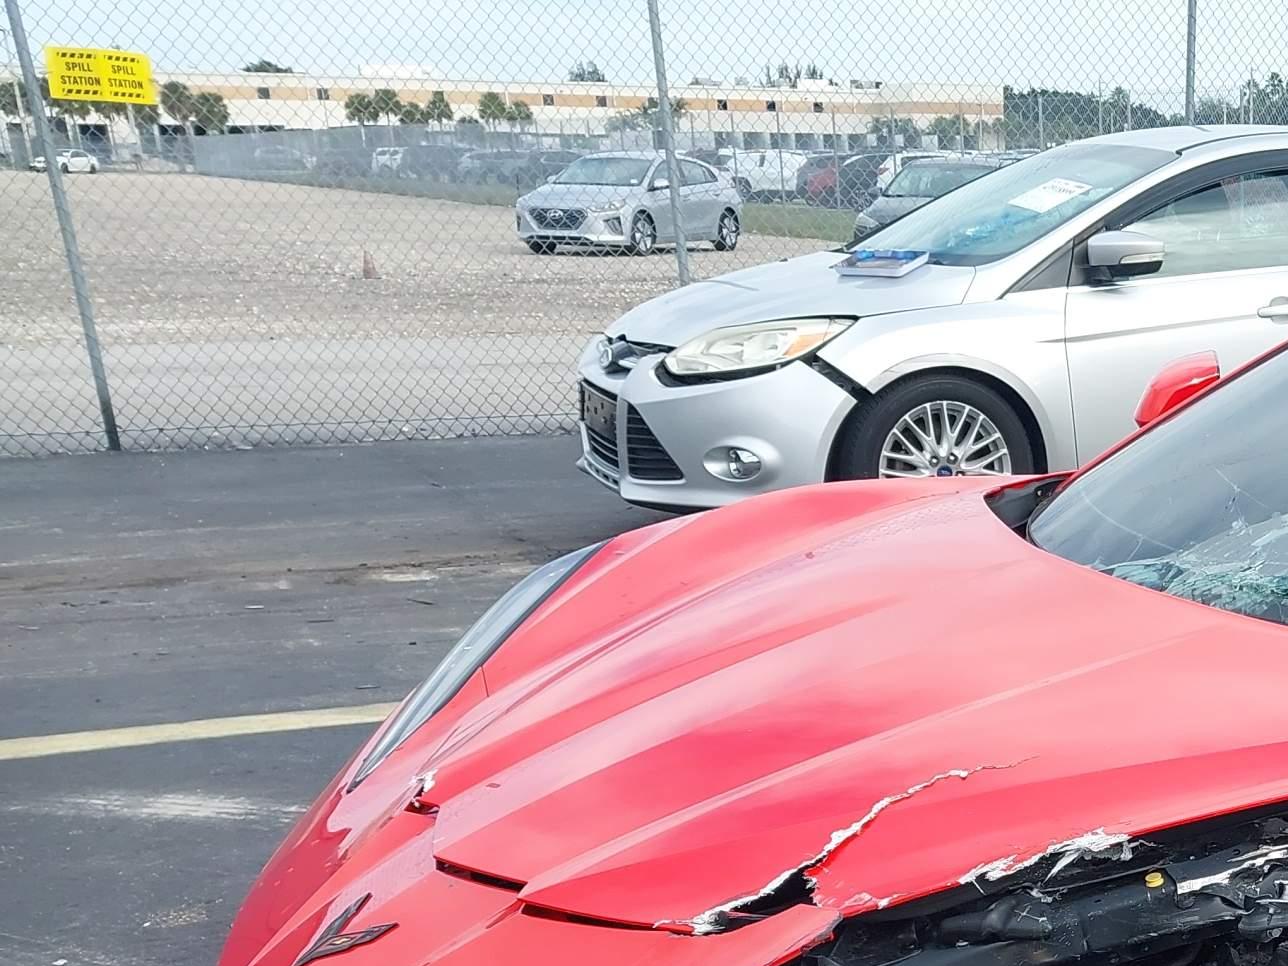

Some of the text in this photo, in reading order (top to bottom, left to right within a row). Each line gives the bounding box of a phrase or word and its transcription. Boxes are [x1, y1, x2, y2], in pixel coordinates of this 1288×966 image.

[64, 61, 94, 73] SPILL
[111, 64, 136, 76] SPILL
[60, 75, 102, 87] STATION
[107, 78, 144, 90] STATION
